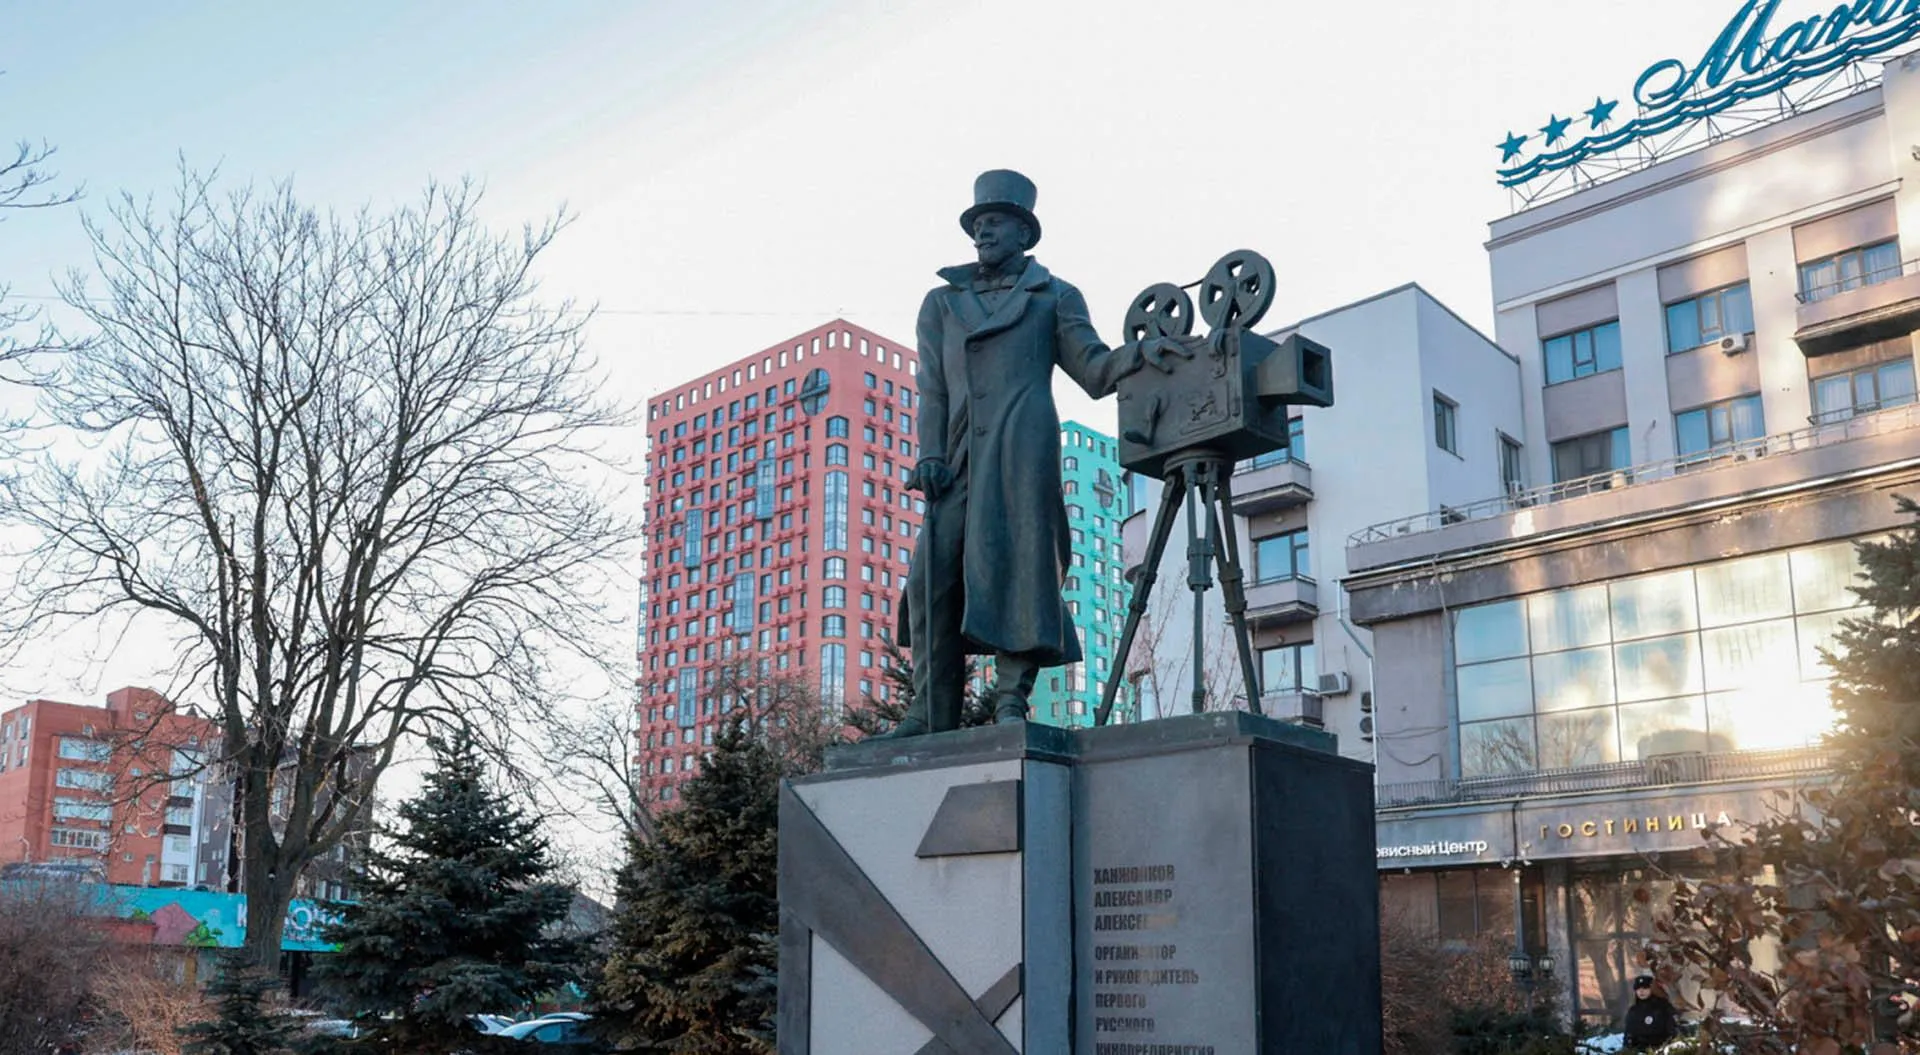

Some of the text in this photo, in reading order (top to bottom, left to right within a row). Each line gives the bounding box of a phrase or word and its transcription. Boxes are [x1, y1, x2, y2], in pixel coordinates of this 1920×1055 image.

[1540, 811, 1732, 839] ГОСТИНИЦА
[1438, 840, 1488, 855] Центр
[1094, 889, 1173, 908] АЛЕКСАНДР
[1095, 969, 1103, 985] И
[1095, 993, 1147, 1009] ПЕРВОГО
[1095, 1017, 1155, 1033] РУССКОГО
